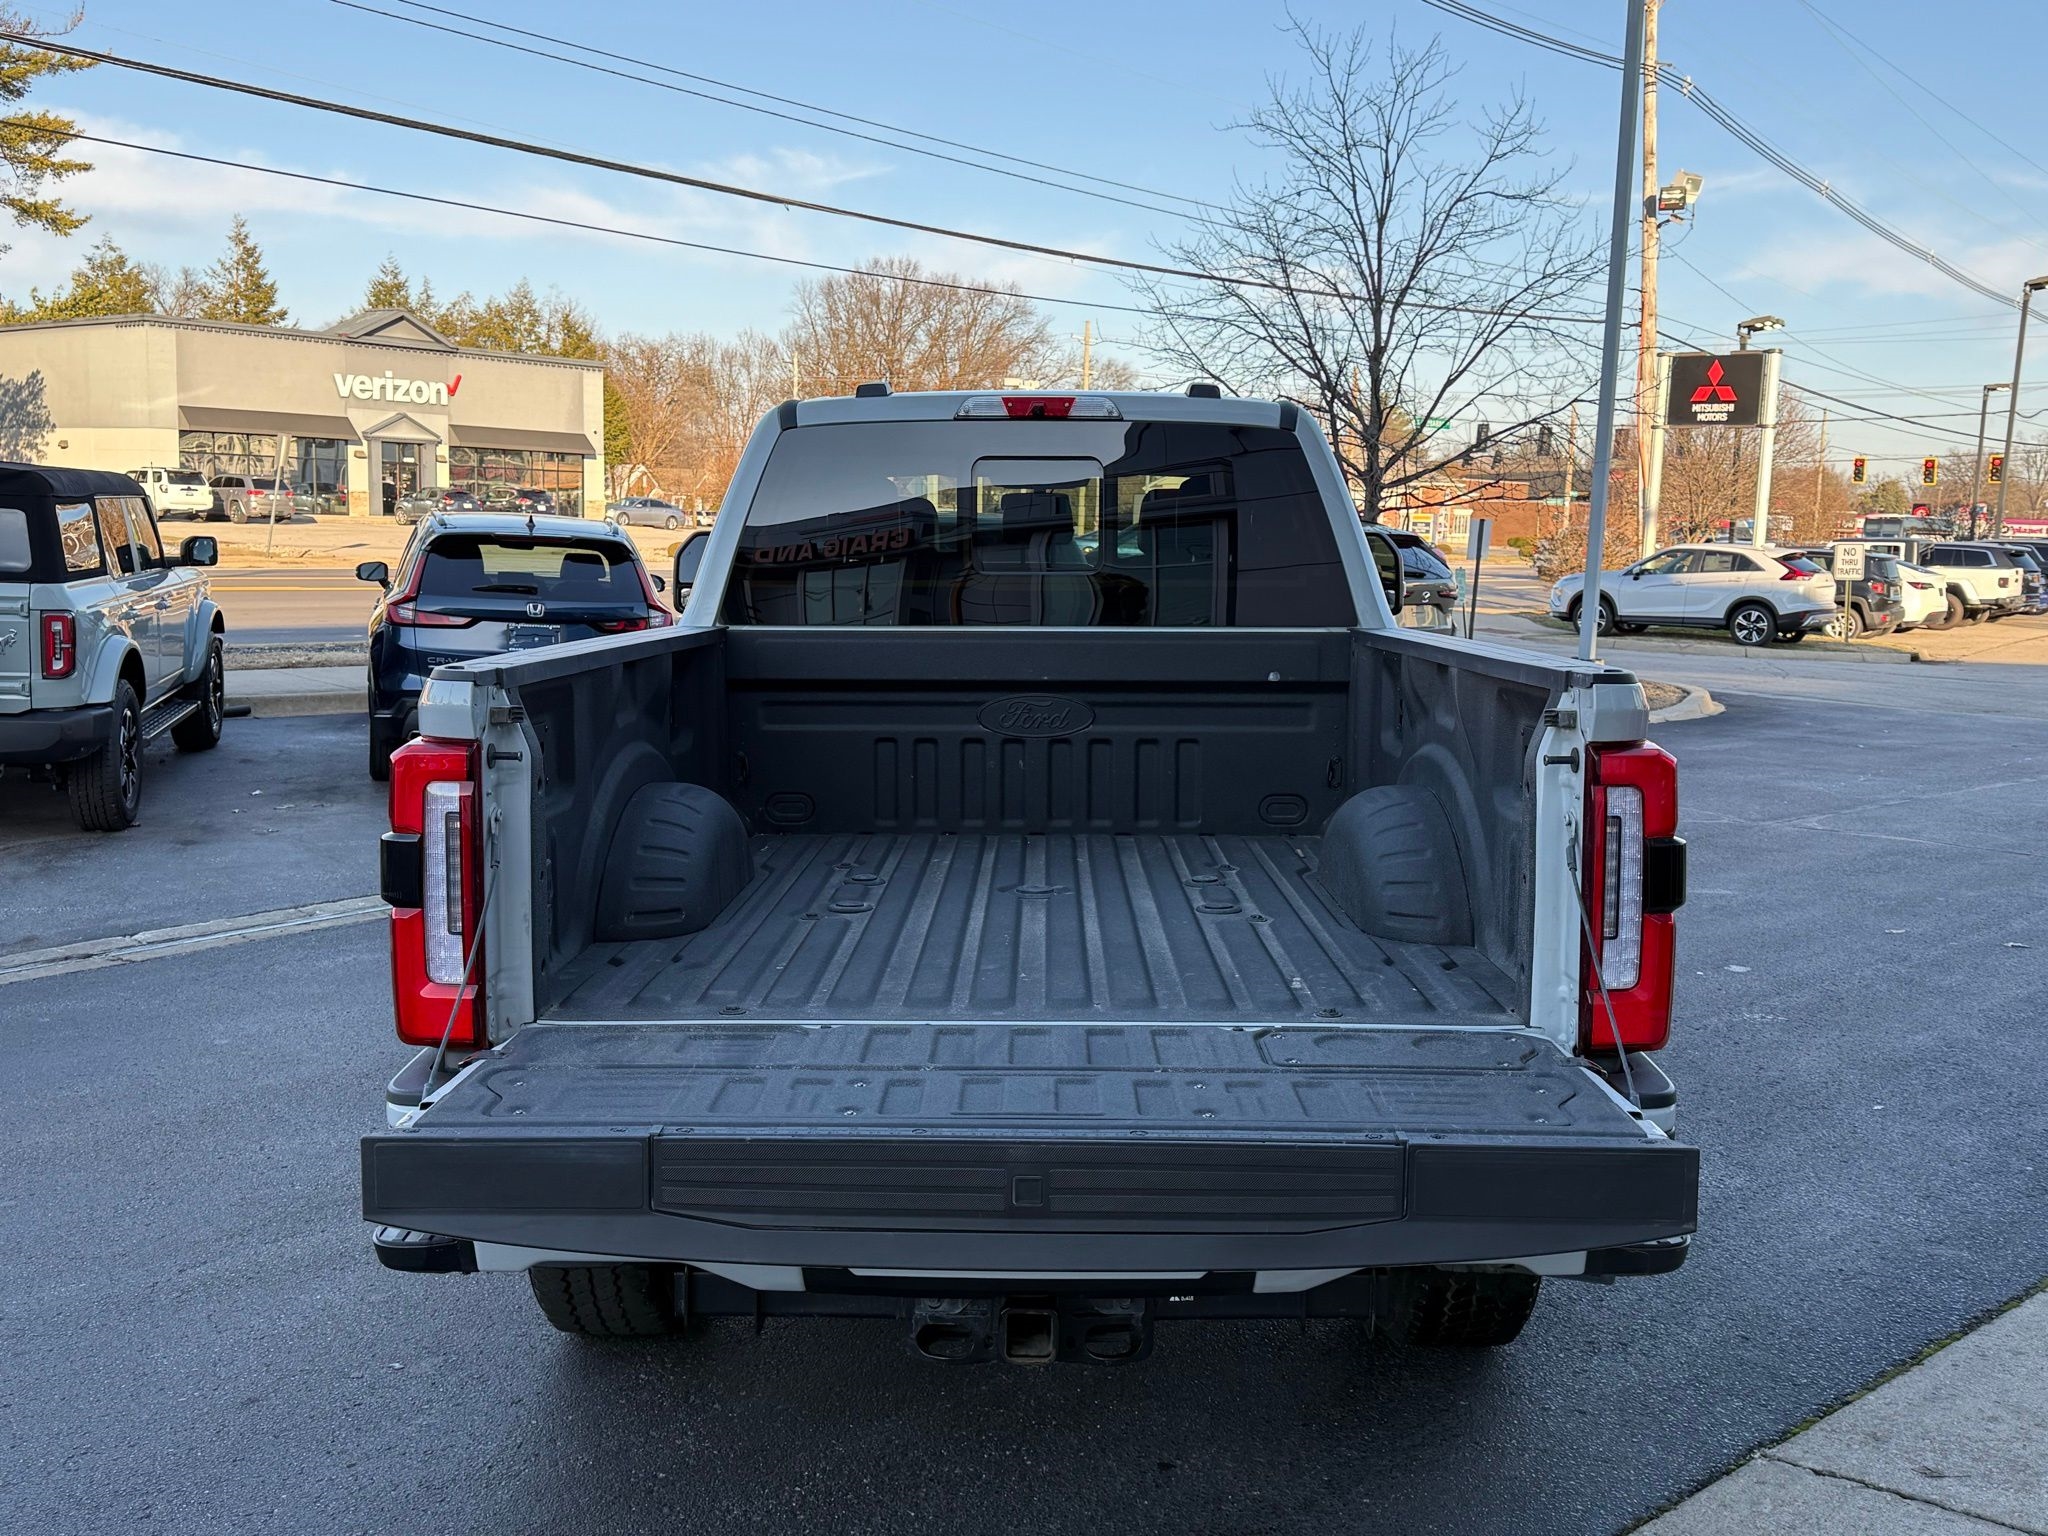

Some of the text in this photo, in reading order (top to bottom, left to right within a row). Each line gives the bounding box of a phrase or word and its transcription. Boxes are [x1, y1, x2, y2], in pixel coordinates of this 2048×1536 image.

[333, 370, 449, 406] verizon
[1692, 403, 1735, 413] MITSUBISHI
[1697, 413, 1728, 421] MOTORS
[1843, 547, 1857, 556] NO
[1837, 568, 1862, 576] TRAFFIC
[1000, 701, 1071, 729] Ford
